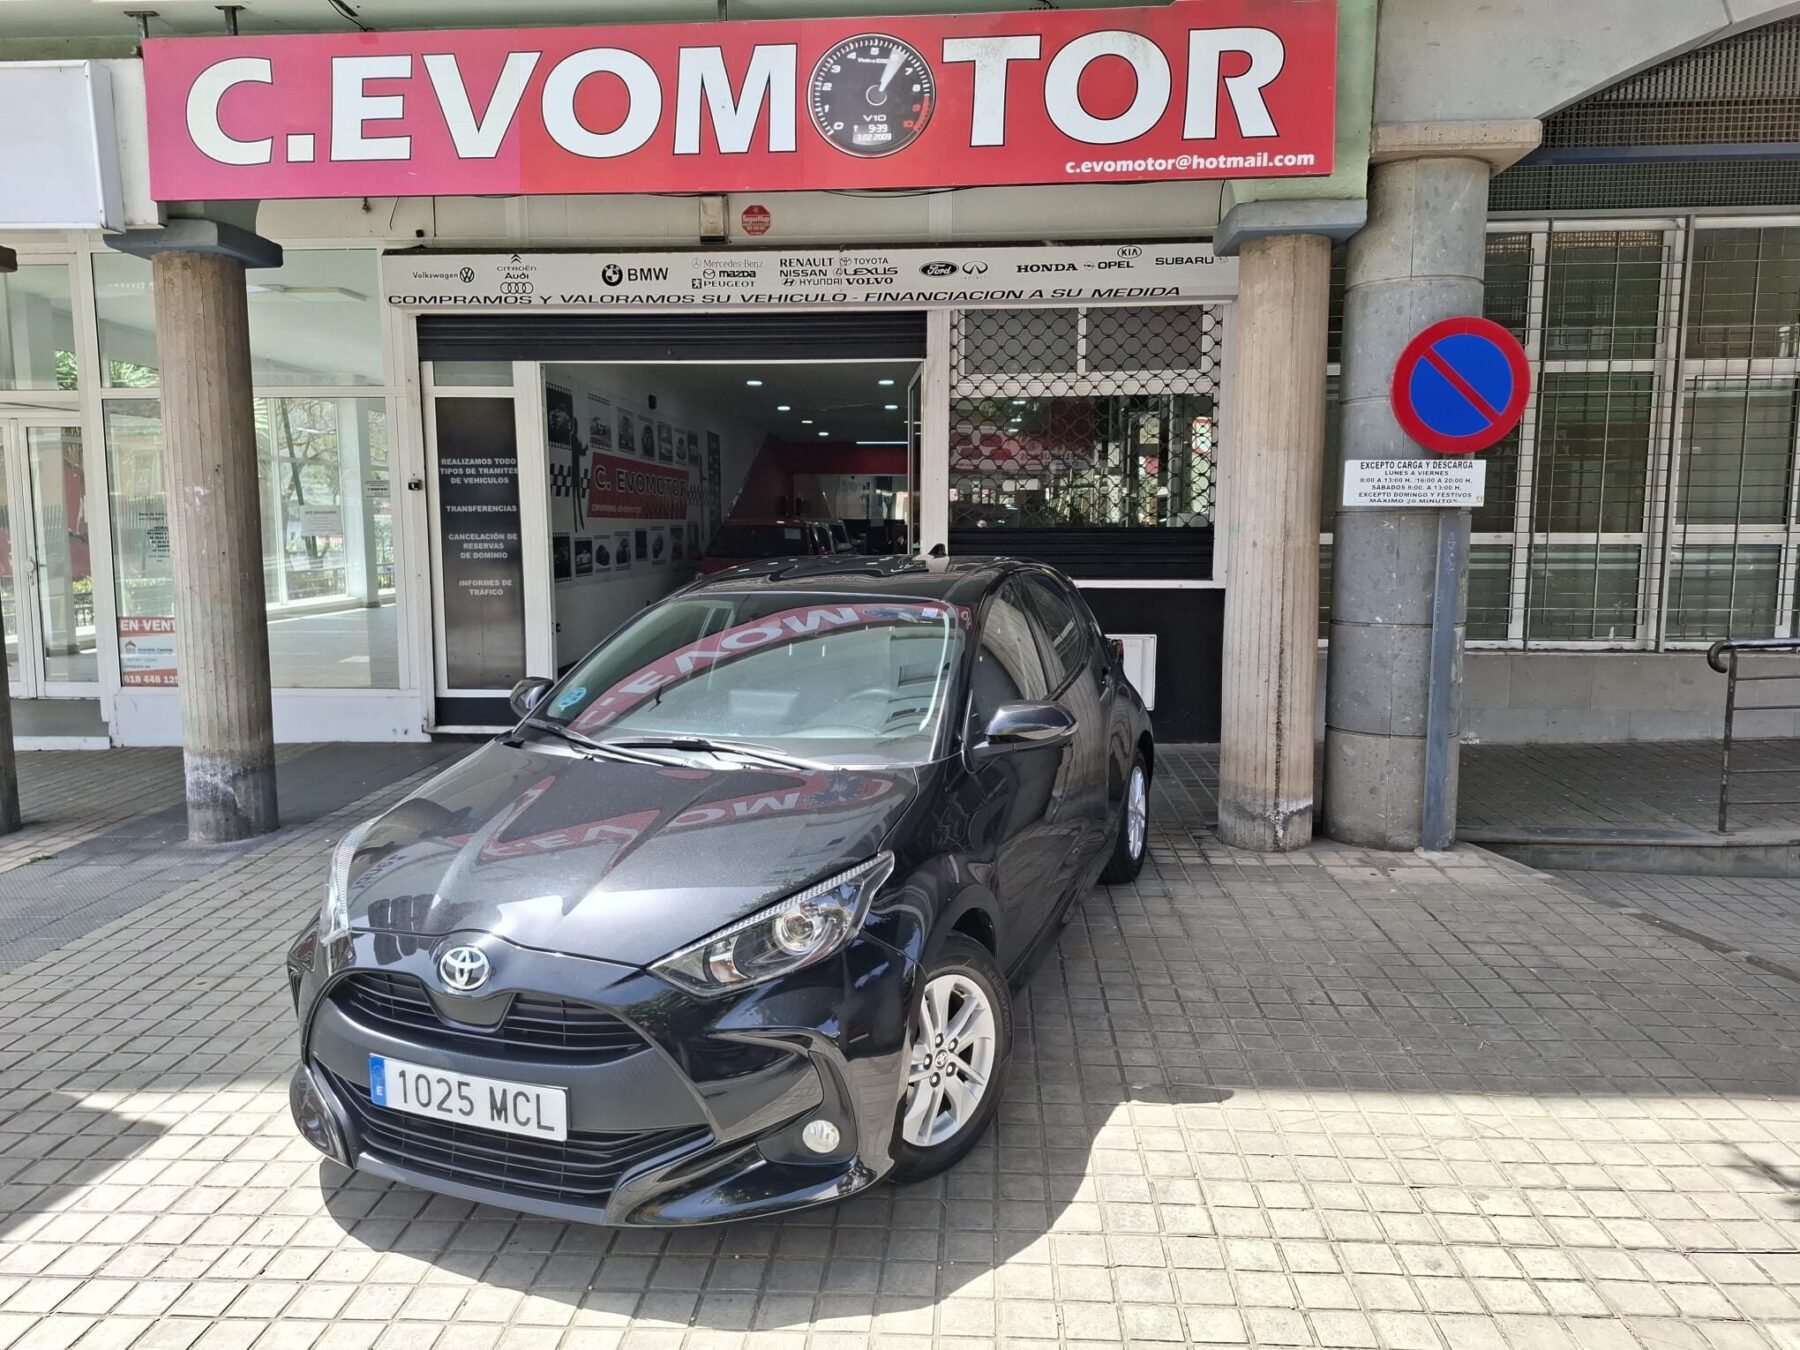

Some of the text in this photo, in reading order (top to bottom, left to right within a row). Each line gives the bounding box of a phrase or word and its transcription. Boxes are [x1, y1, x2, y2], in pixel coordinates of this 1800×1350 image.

[1065, 152, 1315, 174] c.evomotor@hotmail.com
[1120, 248, 1138, 257] KIA
[780, 258, 833, 267] RENAULT
[854, 257, 888, 265] TOYOTA
[1155, 256, 1214, 265] SUBARU
[1016, 263, 1078, 272] HONDA
[1098, 261, 1134, 269] OPEL
[780, 269, 827, 277] NISSAN
[844, 267, 898, 275] LEXUS
[926, 263, 952, 276] Ford
[412, 271, 458, 281] Volkswagen
[504, 272, 529, 280] Audi
[628, 267, 668, 281] BMW
[719, 270, 756, 278] mazda
[704, 280, 755, 288] PEUGEOT
[799, 278, 842, 286] HYUNDAI
[845, 277, 893, 285] VOLVO
[388, 295, 532, 304] COMPRAMOS
[540, 296, 552, 304] Y
[560, 294, 695, 304] VALORAMOS
[702, 294, 731, 303] SU
[740, 293, 847, 303] VEHICULO
[865, 290, 1023, 301] FINANCIACION
[1029, 289, 1044, 298] A
[1051, 288, 1083, 298] SU
[1091, 287, 1180, 297] MEDIDA
[1360, 461, 1473, 469] EXCEPTO CARGA Y DESCARGA
[446, 505, 517, 513] TRANSFERENCIAS
[448, 532, 505, 540] CANCELACIÓN
[120, 619, 139, 631] EN
[376, 1069, 555, 1132] E 1025 MCL
